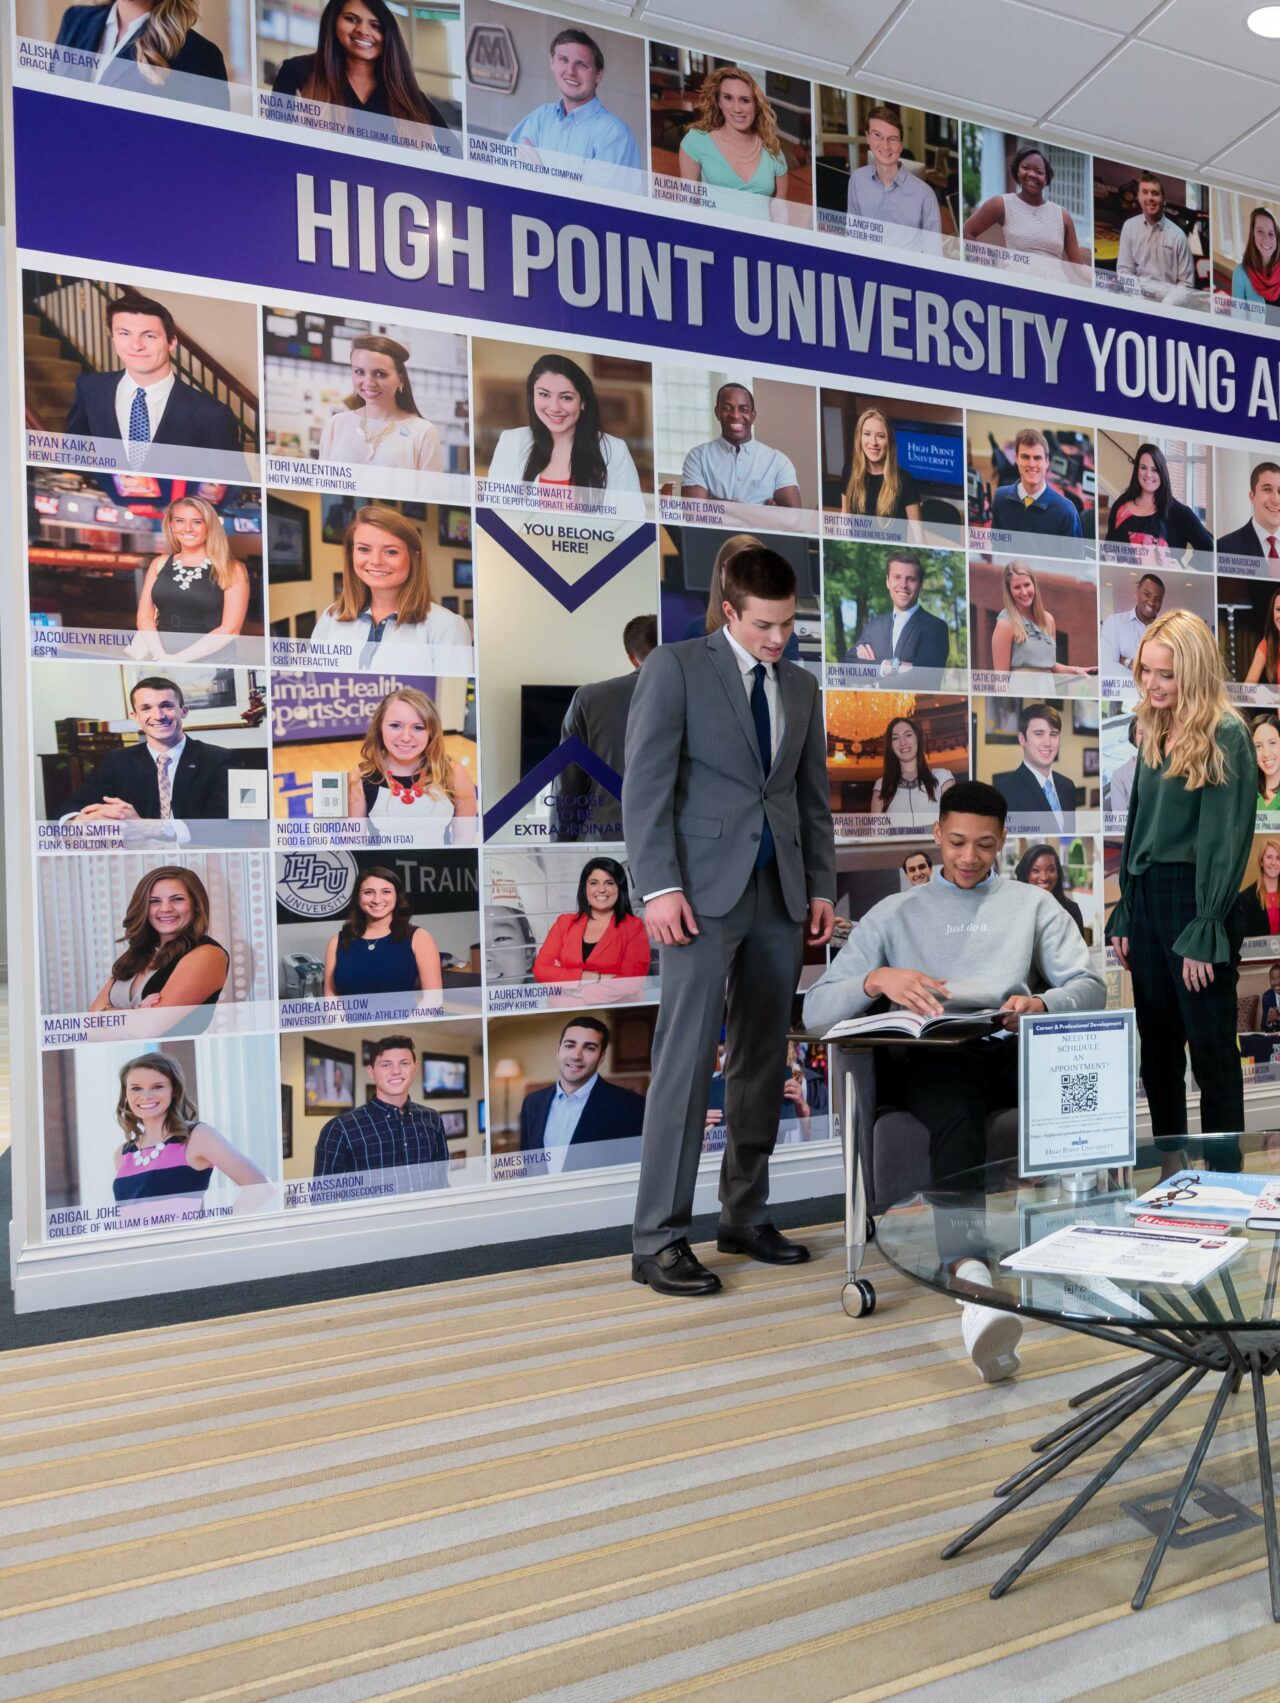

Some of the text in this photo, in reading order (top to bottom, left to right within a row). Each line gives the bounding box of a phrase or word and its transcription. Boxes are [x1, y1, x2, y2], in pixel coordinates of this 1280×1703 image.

[19, 55, 55, 72] ORACLE
[20, 42, 100, 69] ALISHA DEARY
[260, 94, 321, 116] NIDA AHMED
[469, 138, 518, 158] DAN SHORT
[469, 151, 583, 182] MARATHON PETROLEUM COMPANY
[654, 177, 707, 196] ALICIA MILLER
[296, 172, 485, 292] HIGH
[511, 214, 714, 327] POINT
[733, 256, 1068, 385] UNIVERSITY
[1083, 323, 1236, 414] YOUNG
[28, 435, 96, 453] RYAN KAIKA
[907, 441, 955, 457] HIGH POINT
[29, 450, 116, 468] HEWLETT-PACKARD
[907, 452, 955, 467] UNIVERSITY
[268, 459, 352, 478] TORI VALENTINAS
[268, 474, 357, 491] HGTV HOME FURNITURE
[477, 480, 572, 500] STEPHANIE SCHWARTZ
[824, 515, 873, 529] BRITTON NAGY
[524, 522, 615, 542] YOU BELONG
[970, 530, 1012, 543] ALEX PALMER
[552, 540, 589, 554] HERE!
[33, 631, 134, 646] JACQUELYN REILLY
[34, 645, 58, 656] ESPN
[272, 642, 353, 656] KRISTA WILLARD
[272, 656, 340, 667] CBS INTERACTIVE
[827, 666, 877, 677] JOHN HOLLAND
[544, 795, 605, 807] CHOOSE
[38, 824, 120, 837] GORDON SMITH
[277, 822, 361, 834] NICOLE GIORDANO
[514, 823, 622, 836] EXTRAORDINAR
[277, 835, 414, 846] FOOD & DRUG ADMINISTRATION (FDA)
[277, 853, 348, 894] HPU
[285, 895, 347, 913] UNIVERSITY
[946, 921, 964, 935] Just
[966, 921, 979, 931] do
[489, 986, 563, 1001] LAUREN MCGRAW
[281, 998, 369, 1014] ANDREA BAELLOW
[489, 999, 539, 1012] KRISPY KREME
[44, 1014, 127, 1031] MARIN SEIFERT
[281, 1006, 444, 1027] UNIVERSITY OF VIRGINIA-ATHLETIC TRAINING
[1059, 1022, 1090, 1030] Professional
[1090, 1020, 1122, 1029] Development
[45, 1032, 88, 1044] KETCHUM
[1061, 1033, 1097, 1043] NEED TO
[1057, 1043, 1099, 1053] SCHEDULE
[1049, 1062, 1110, 1073] APPOINTMENT?
[494, 1151, 552, 1168] JAMES HYLAS
[286, 1175, 364, 1194] TYE MASSARONI
[286, 1183, 394, 1206] PRICEWATERHOUSECOOPERS
[49, 1205, 122, 1225] ABIGAIL JOHE
[49, 1206, 234, 1238] COLLEGE OF WILLIAM & MARY- ACCOUNTING
[1153, 1217, 1224, 1230] Handshake
